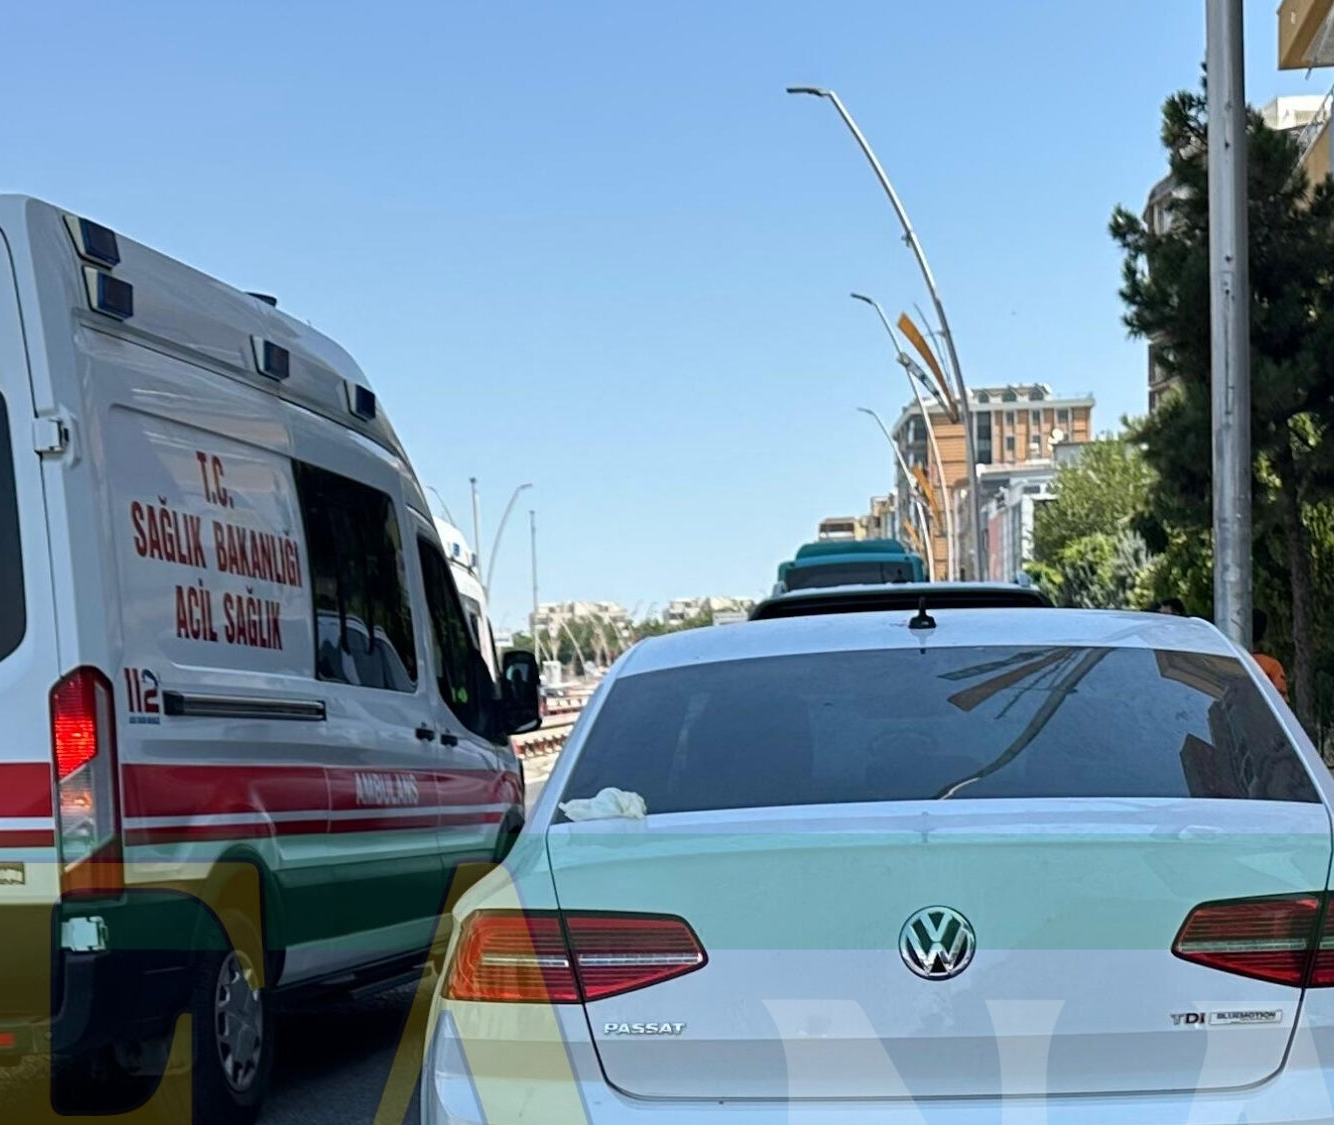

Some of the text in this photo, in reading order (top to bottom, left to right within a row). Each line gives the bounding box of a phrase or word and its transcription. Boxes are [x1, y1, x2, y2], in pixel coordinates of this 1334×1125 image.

[196, 450, 235, 509] T.C.
[131, 495, 303, 588] SAĞLIK BAKANLIĞI
[176, 578, 283, 650] ACİL SAĞLIK
[354, 771, 418, 807] AMBULANS
[604, 1022, 686, 1036] PASSAT
[1170, 1012, 1206, 1025] TDI
